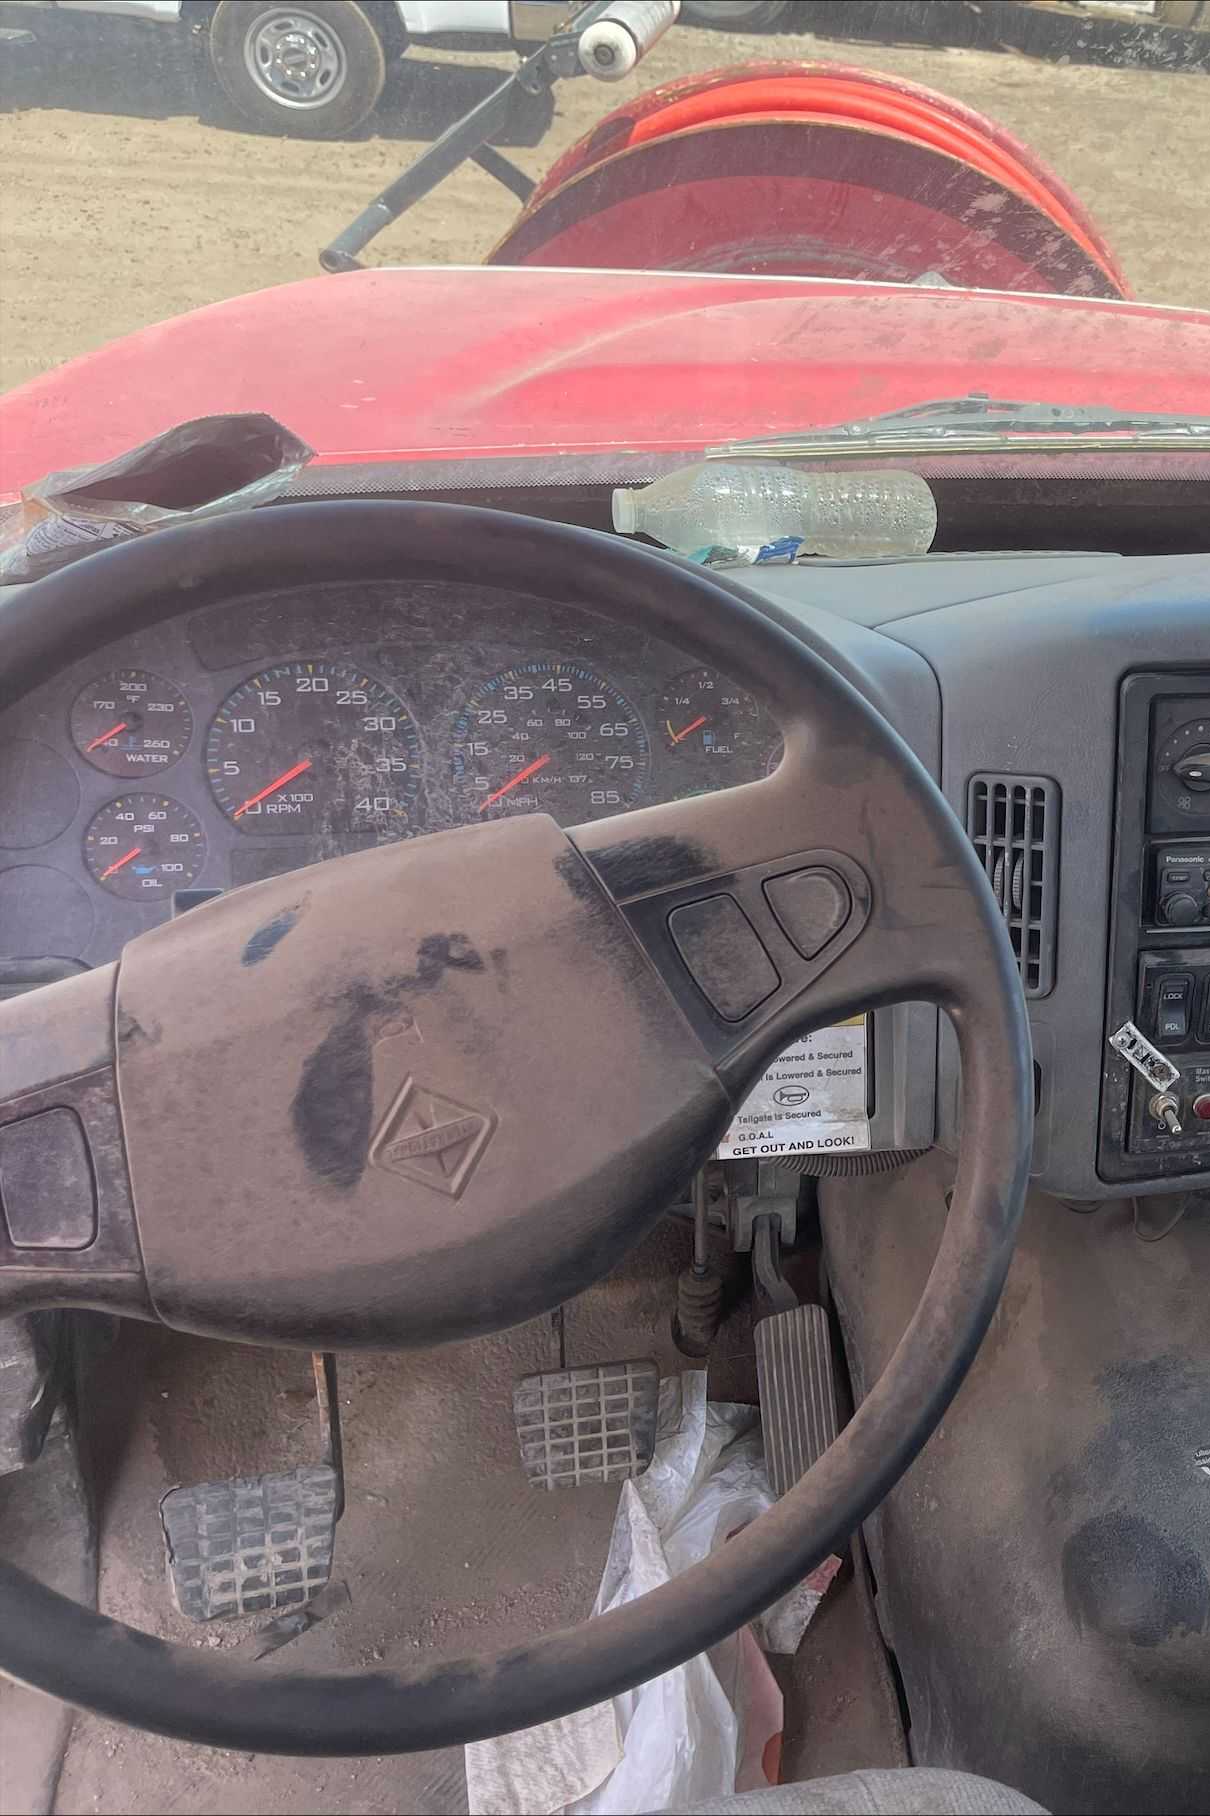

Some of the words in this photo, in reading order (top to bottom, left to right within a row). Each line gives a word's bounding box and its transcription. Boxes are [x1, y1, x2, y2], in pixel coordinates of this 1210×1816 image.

[120, 683, 147, 691] 200
[296, 678, 329, 692] 20
[542, 678, 572, 692] 45
[698, 681, 714, 689] 1/2
[258, 691, 281, 705] 15
[336, 691, 368, 705] 25
[503, 686, 534, 700] 35
[94, 701, 115, 709] 170
[577, 696, 606, 709] 55
[721, 697, 739, 705] 3/4
[147, 703, 174, 712] 230
[478, 710, 507, 724] 25
[527, 719, 543, 727] 60
[555, 719, 571, 727] 80
[230, 718, 255, 733] 10
[363, 717, 396, 731] 30
[600, 723, 628, 736] 65
[512, 732, 529, 741] 40
[467, 742, 489, 756] 15
[126, 753, 168, 763] WATER
[508, 754, 525, 762] 20
[604, 756, 634, 769] 75
[224, 761, 240, 775] 5
[376, 758, 406, 772] 35
[475, 776, 489, 790] 5
[591, 791, 620, 804] 85
[266, 804, 301, 814] RPM
[355, 797, 390, 811] 40
[115, 812, 134, 820] 40
[148, 811, 167, 819] 60
[133, 824, 154, 832] PSI
[100, 836, 118, 844] 20
[170, 834, 189, 842] 80
[160, 863, 183, 872] 100
[141, 879, 163, 887] OIL
[1165, 1023, 1181, 1031] PDL
[808, 1053, 815, 1061] &
[817, 1050, 853, 1060] Secured
[776, 1070, 815, 1080] Lowered
[817, 1069, 823, 1077] &
[826, 1067, 862, 1077] Secured
[738, 1115, 772, 1125] Tailgate
[785, 1110, 821, 1119] Secured
[732, 1146, 758, 1156] GET
[760, 1143, 785, 1153] OUT
[788, 1140, 814, 1151] AND
[817, 1136, 855, 1148] LOOK!
